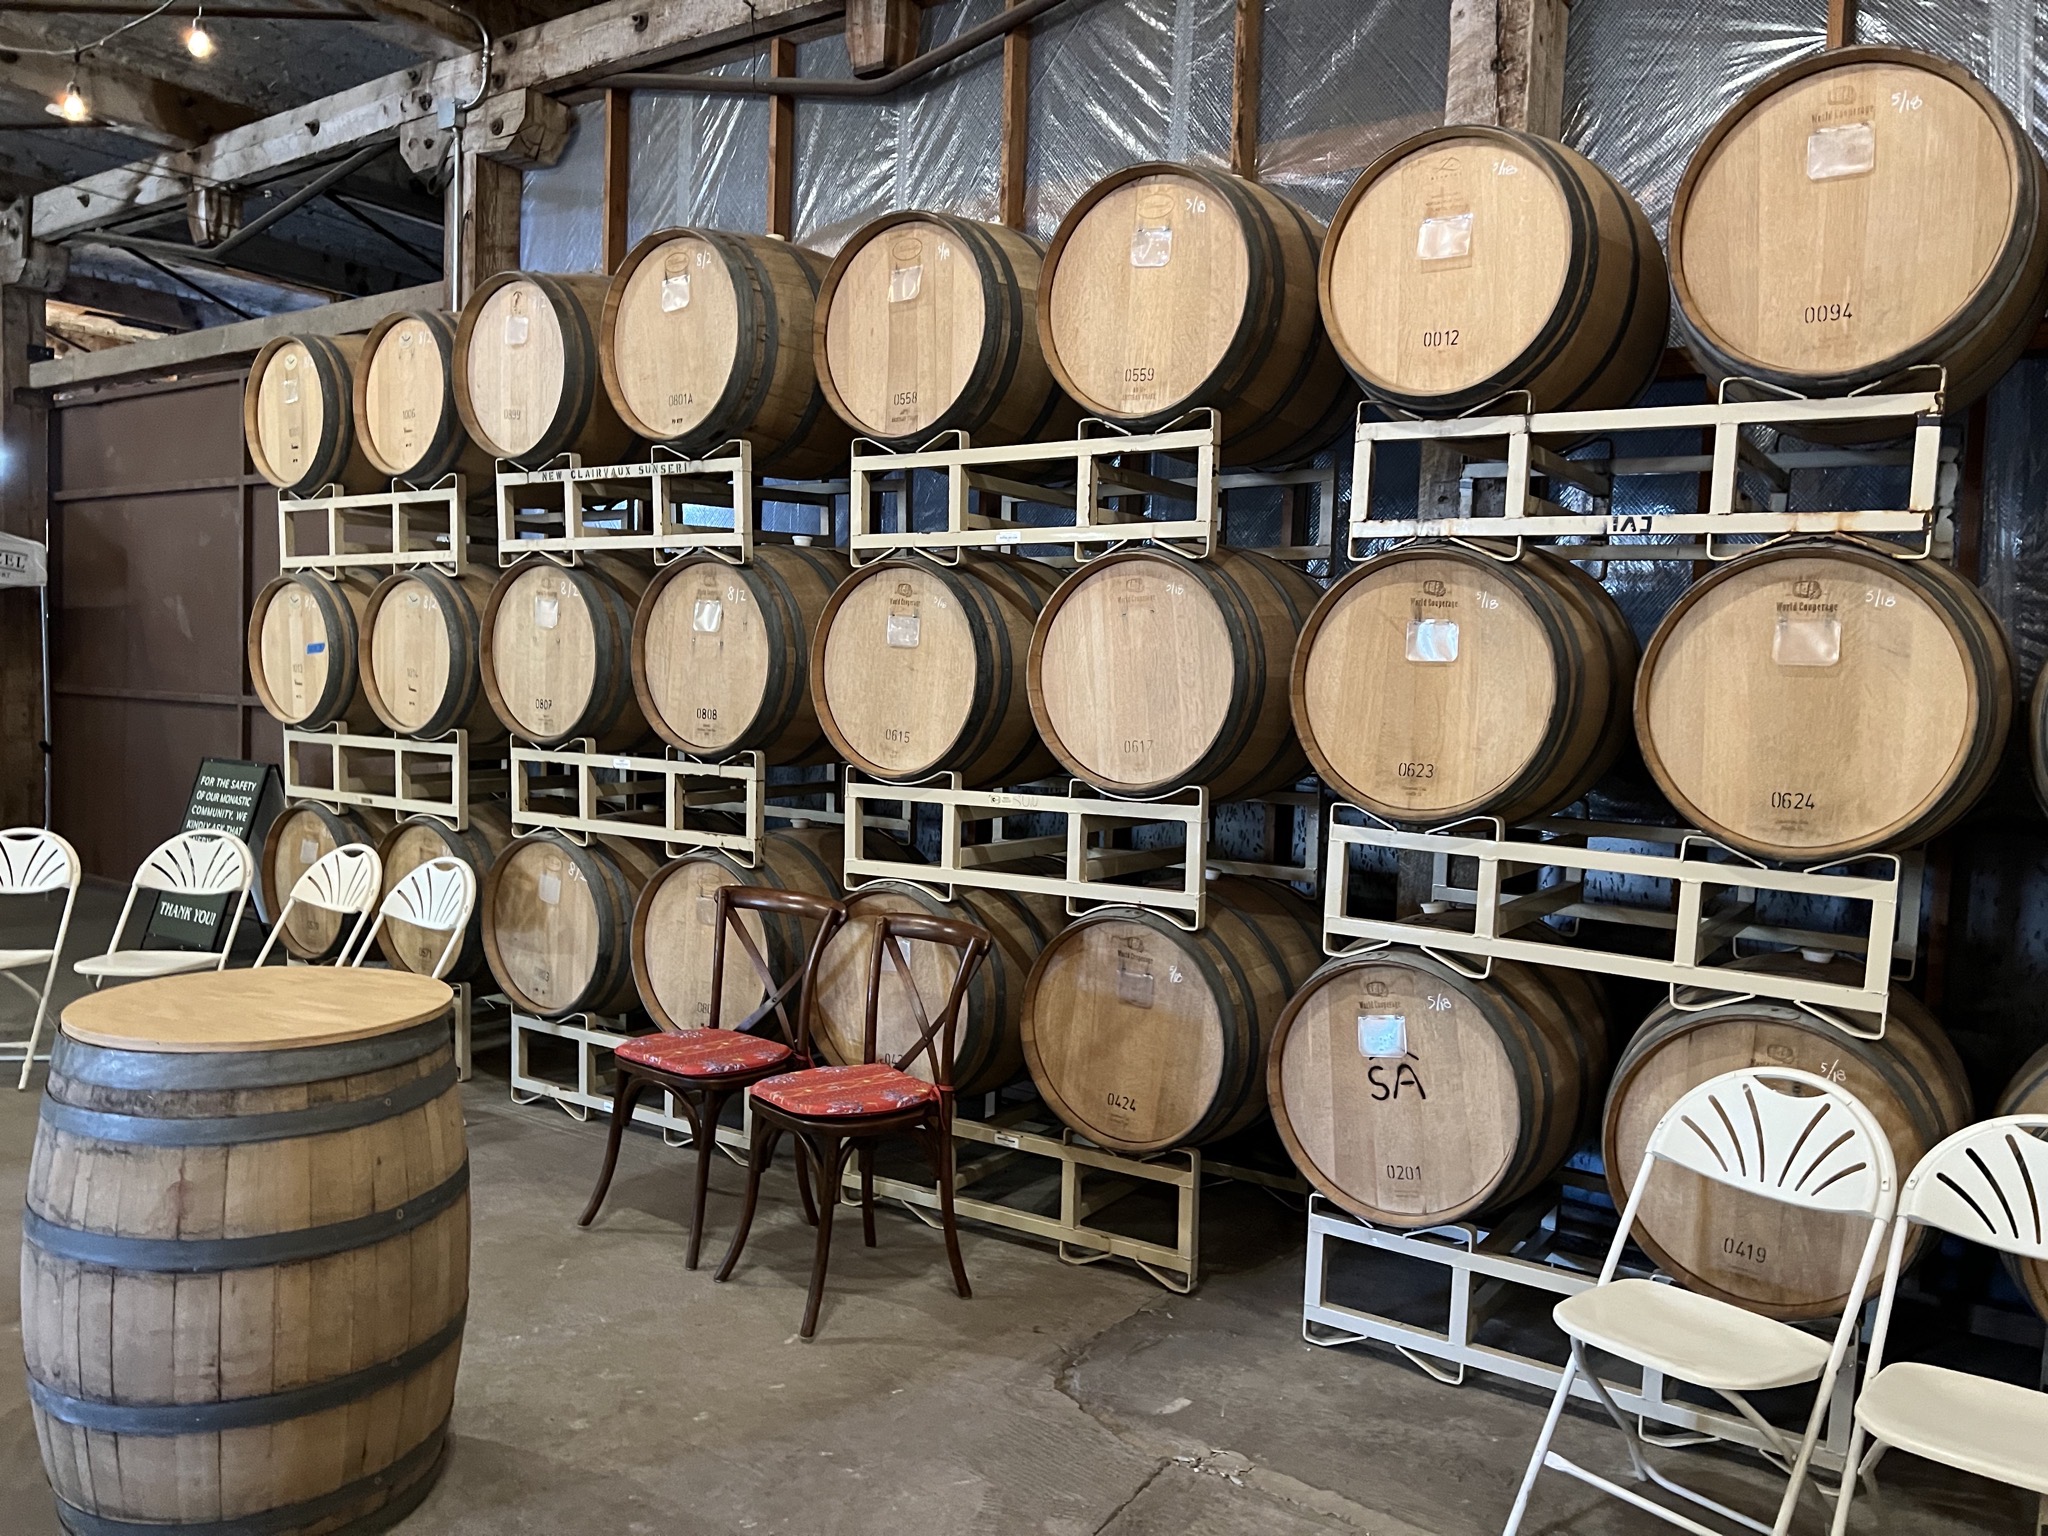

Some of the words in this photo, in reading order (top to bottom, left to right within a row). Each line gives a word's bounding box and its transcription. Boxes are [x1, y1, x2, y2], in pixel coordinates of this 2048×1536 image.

[1804, 303, 1853, 324] 0094
[1423, 329, 1459, 347] 0012
[1124, 368, 1155, 382] 0559
[893, 391, 918, 406] 0558
[541, 471, 562, 482] NEW
[570, 466, 632, 480] CLAIRVAUX
[727, 586, 747, 604] 8/2
[1865, 588, 1896, 608] 5/18
[1775, 602, 1797, 612] World
[696, 708, 718, 721] 0808
[885, 728, 911, 744] 0615
[1124, 739, 1154, 754] 0617
[1398, 763, 1434, 779] 0623
[200, 775, 214, 787] FOR
[215, 777, 230, 789] THE
[229, 779, 257, 792] SAFETY
[196, 790, 206, 800] OF
[205, 791, 220, 803] OUR
[219, 793, 252, 807] MONASTIC
[1771, 791, 1815, 810] 0624
[191, 804, 235, 821] COMMUNITY,
[236, 811, 249, 822] WE
[226, 825, 244, 837] THAT
[159, 901, 193, 921] THANK
[193, 908, 217, 927] YOU!
[1427, 993, 1452, 1012] 5/18
[1820, 1058, 1847, 1083] 5/18
[1367, 1063, 1427, 1101] SA
[1107, 1092, 1137, 1112] 0424
[1386, 1164, 1422, 1181] 0201
[1723, 1236, 1767, 1264] 0419
